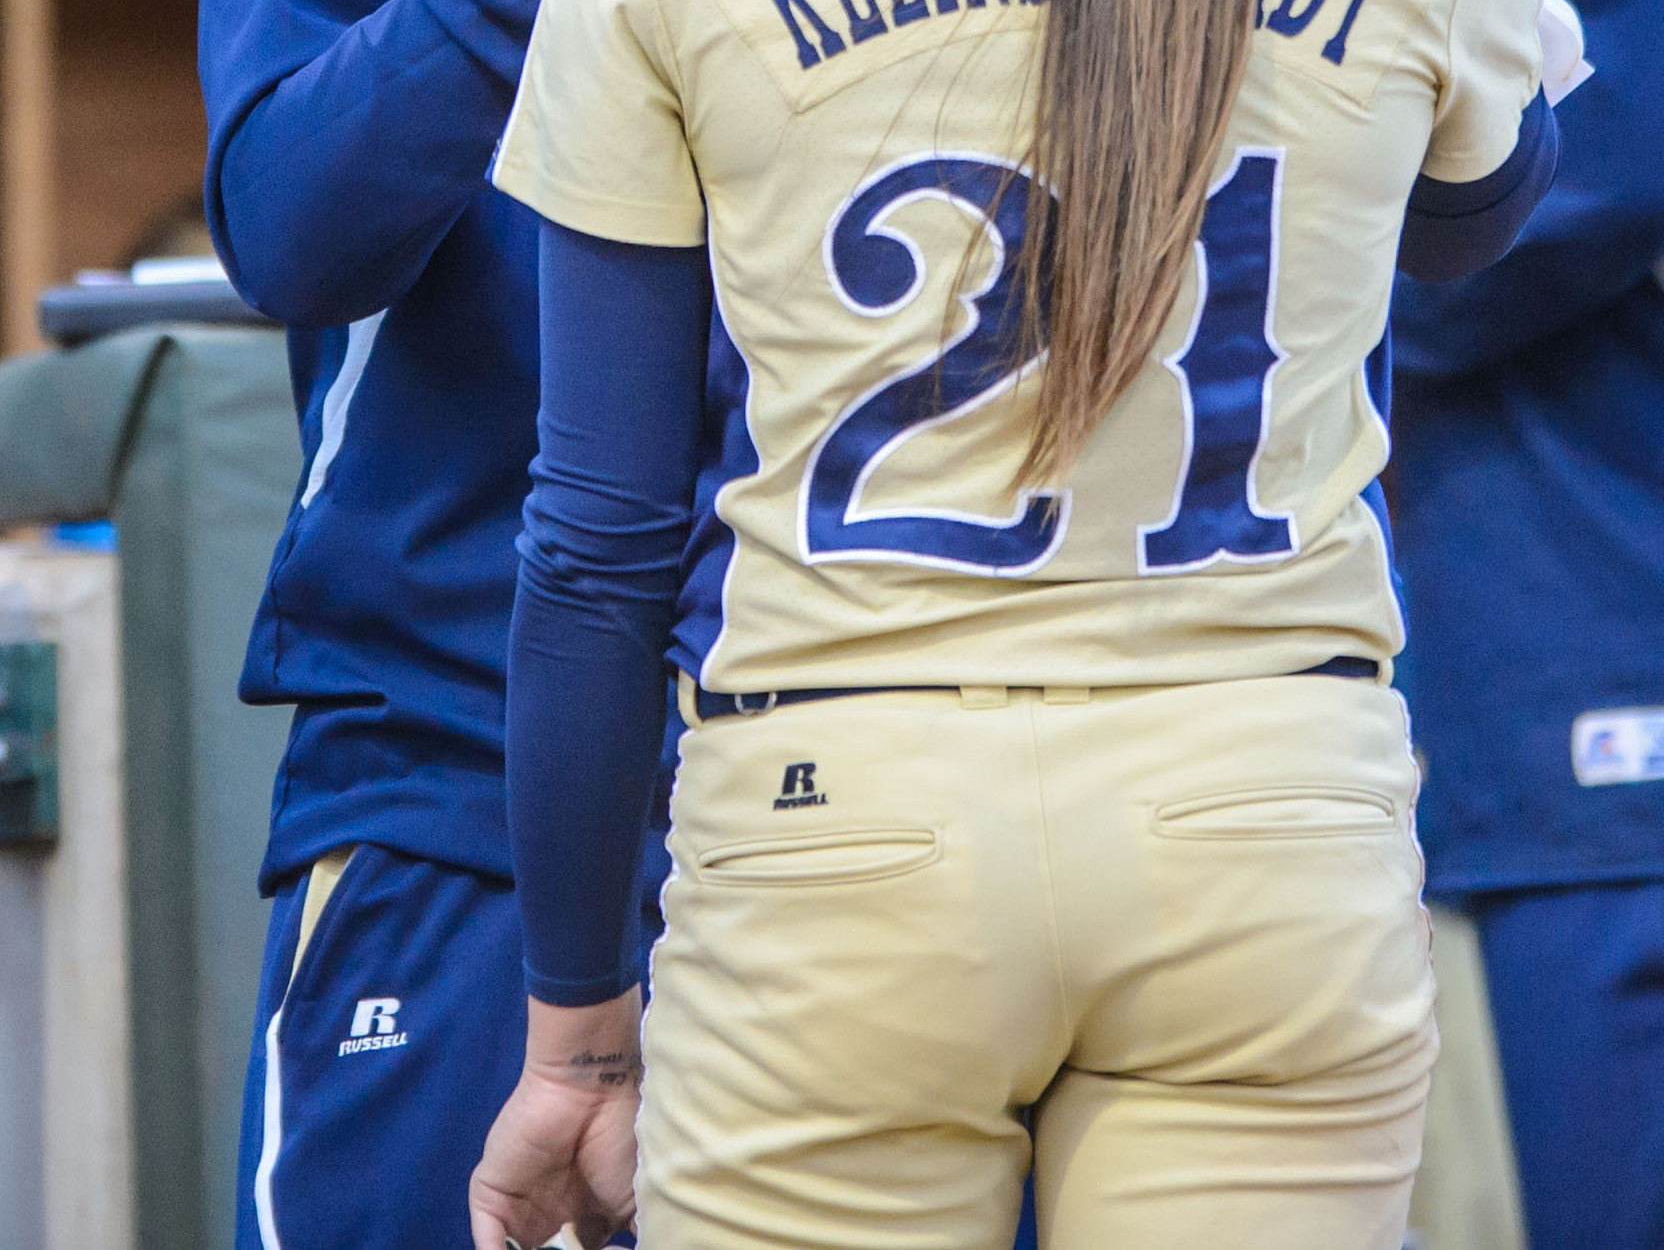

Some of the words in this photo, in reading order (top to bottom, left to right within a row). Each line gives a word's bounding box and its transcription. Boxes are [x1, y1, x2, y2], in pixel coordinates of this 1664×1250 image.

[799, 146, 1299, 578] 21
[781, 762, 817, 796] R
[350, 997, 401, 1037] R
[338, 1031, 408, 1057] RUSSELL
